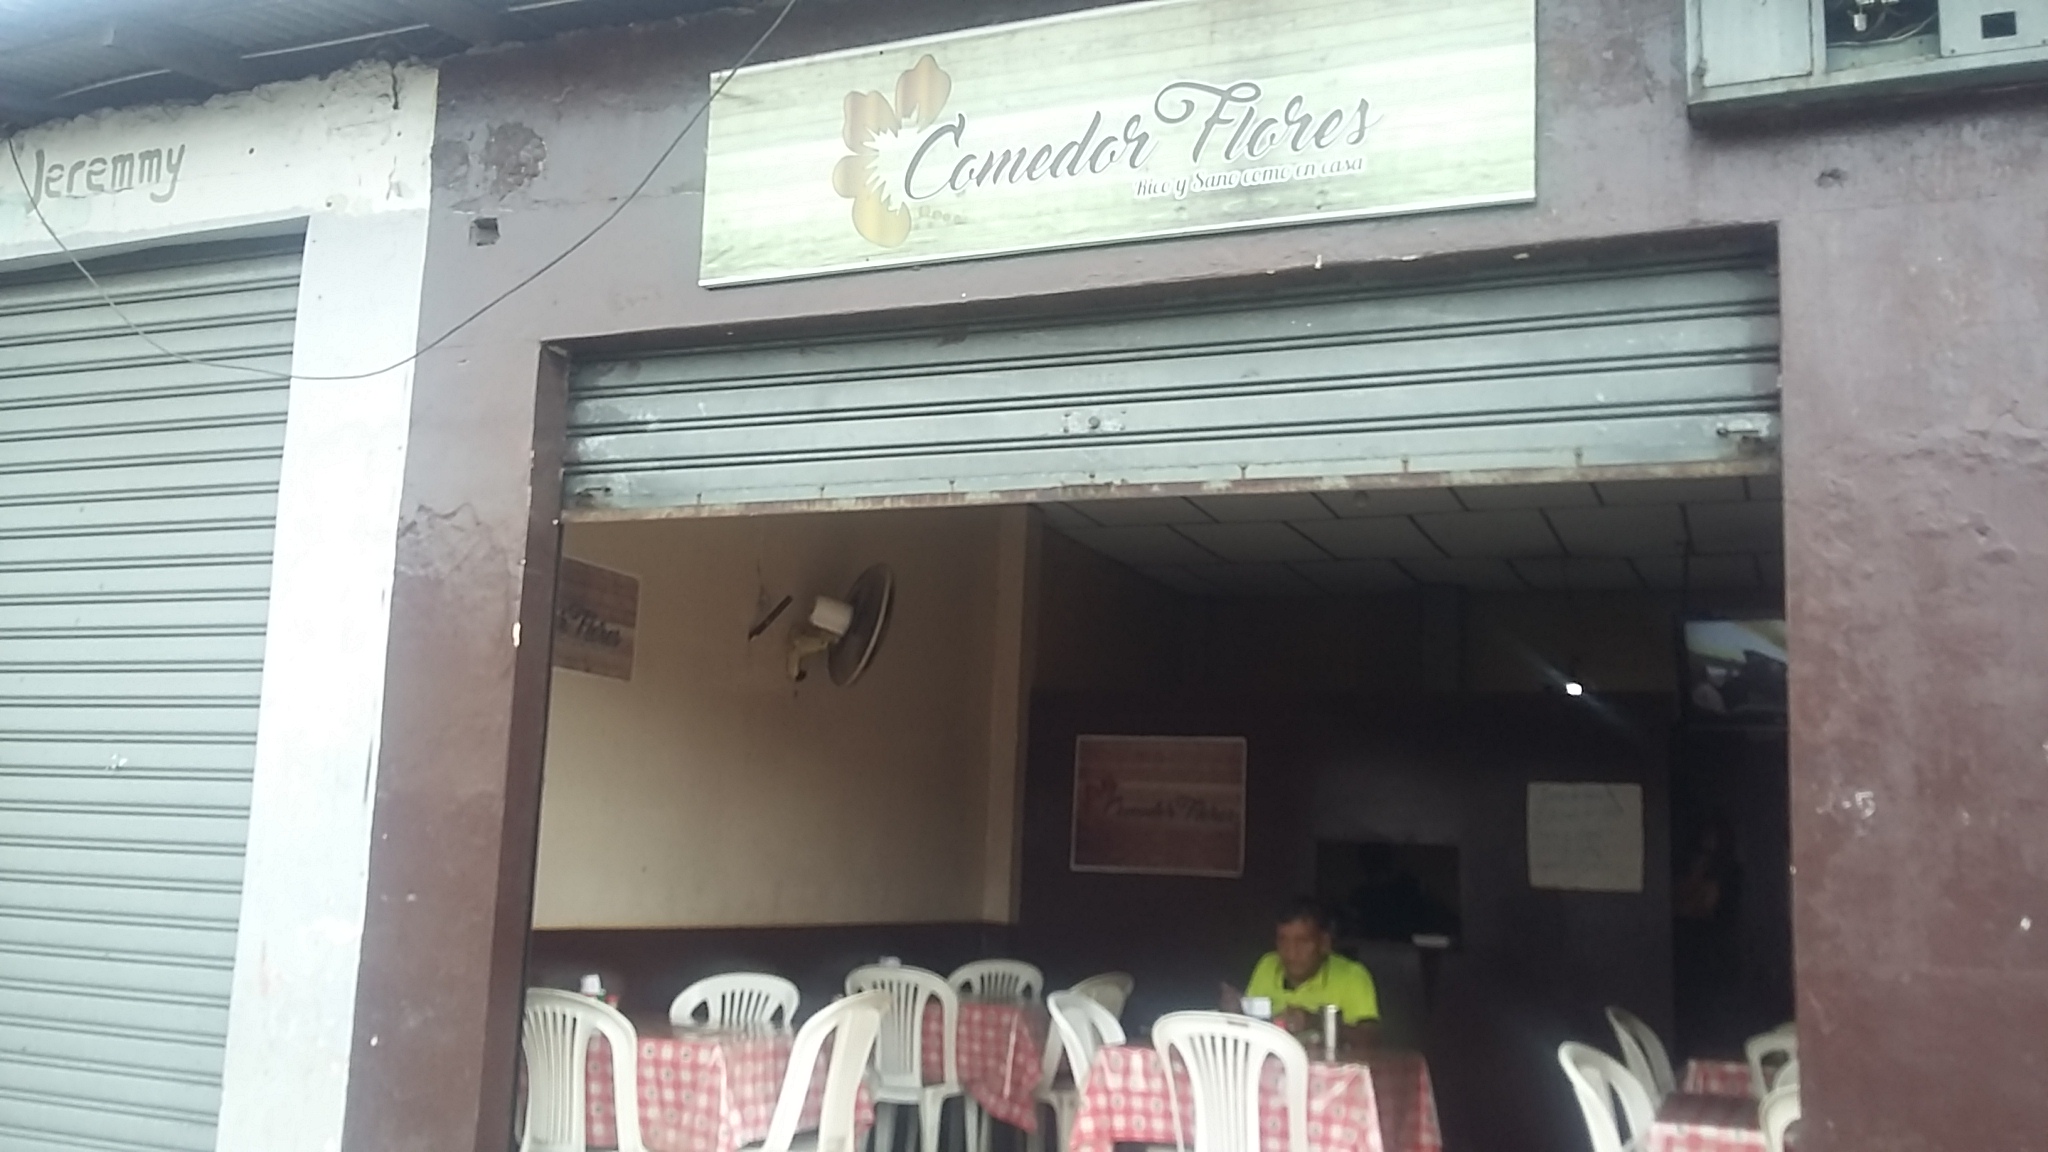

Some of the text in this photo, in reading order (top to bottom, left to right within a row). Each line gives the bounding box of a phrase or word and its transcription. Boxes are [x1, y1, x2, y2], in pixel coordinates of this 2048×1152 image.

[905, 81, 1382, 200] Comedor Flores
[24, 143, 186, 215] Jeremmy
[1135, 156, 1364, 199] Rico y Sano como en casa
